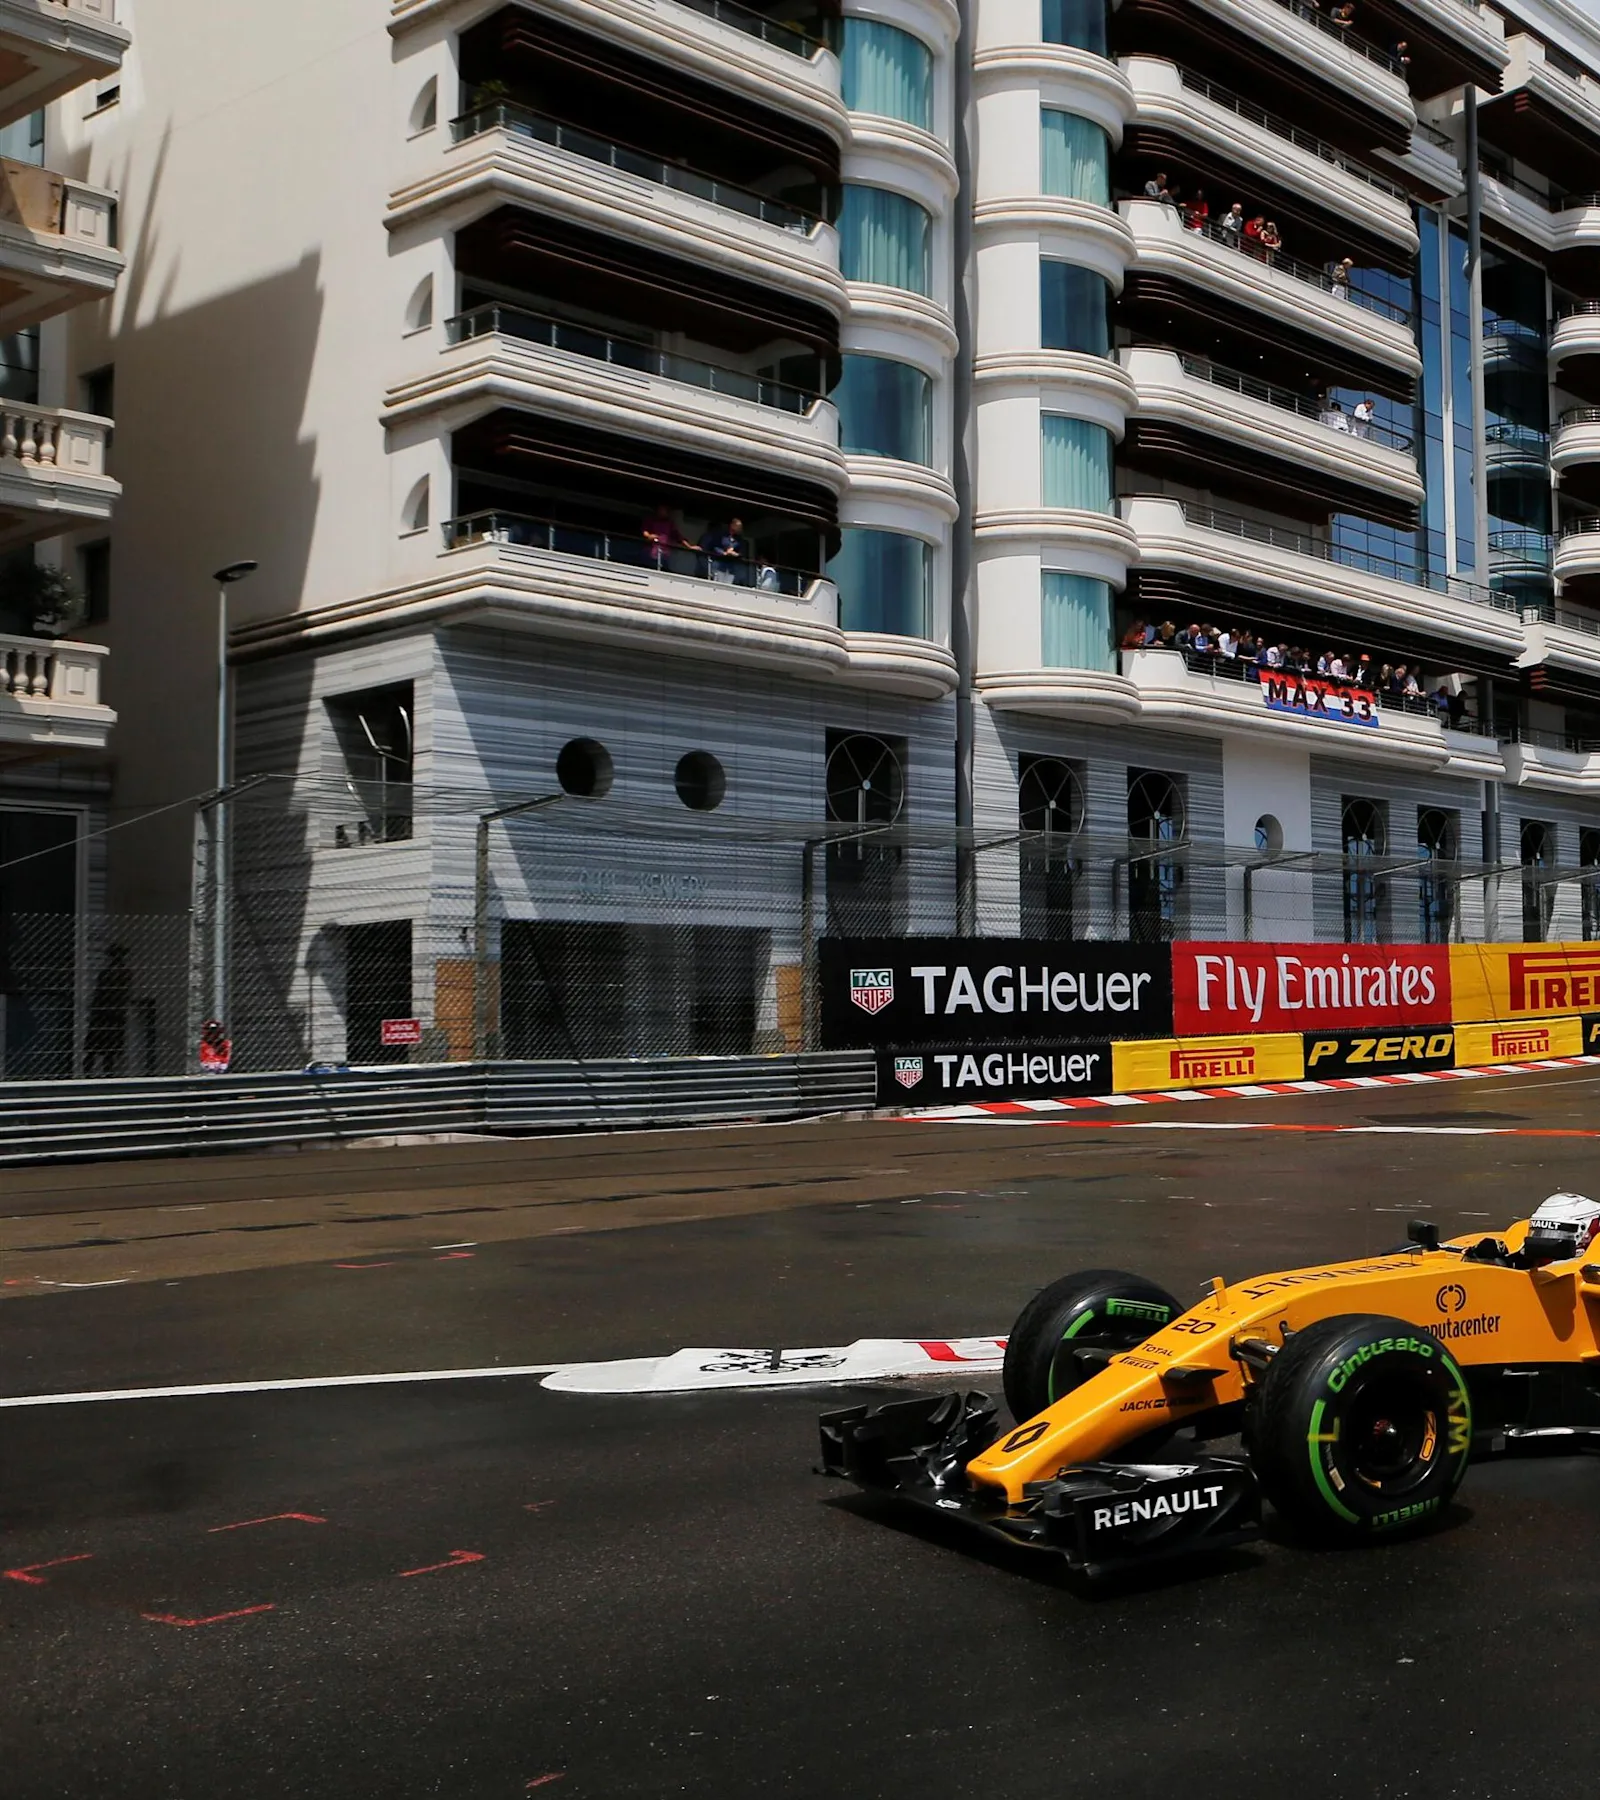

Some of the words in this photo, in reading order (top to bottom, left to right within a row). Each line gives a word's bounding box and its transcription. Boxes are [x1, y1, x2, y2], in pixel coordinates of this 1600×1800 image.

[1267, 677, 1329, 713] MAX
[1340, 690, 1372, 721] 33
[854, 971, 890, 986] TAG
[1195, 954, 1266, 1023] Fly
[1275, 952, 1436, 1010] Emirates
[853, 989, 891, 1011] HEUER
[1308, 1040, 1339, 1066] P
[1345, 1033, 1453, 1064] ZERO
[1491, 1028, 1549, 1057] PIRELLI
[898, 1059, 921, 1070] TAG
[1169, 1046, 1255, 1080] PIRELLI
[1242, 1261, 1421, 1300] RENAULT
[1106, 1298, 1170, 1323] PIRELLI
[1171, 1318, 1216, 1334] 20
[1421, 1313, 1500, 1340] putacenter
[1119, 1356, 1160, 1370] PIRELLI
[1119, 1400, 1153, 1412] JACK
[1094, 1486, 1223, 1530] RENAULT
